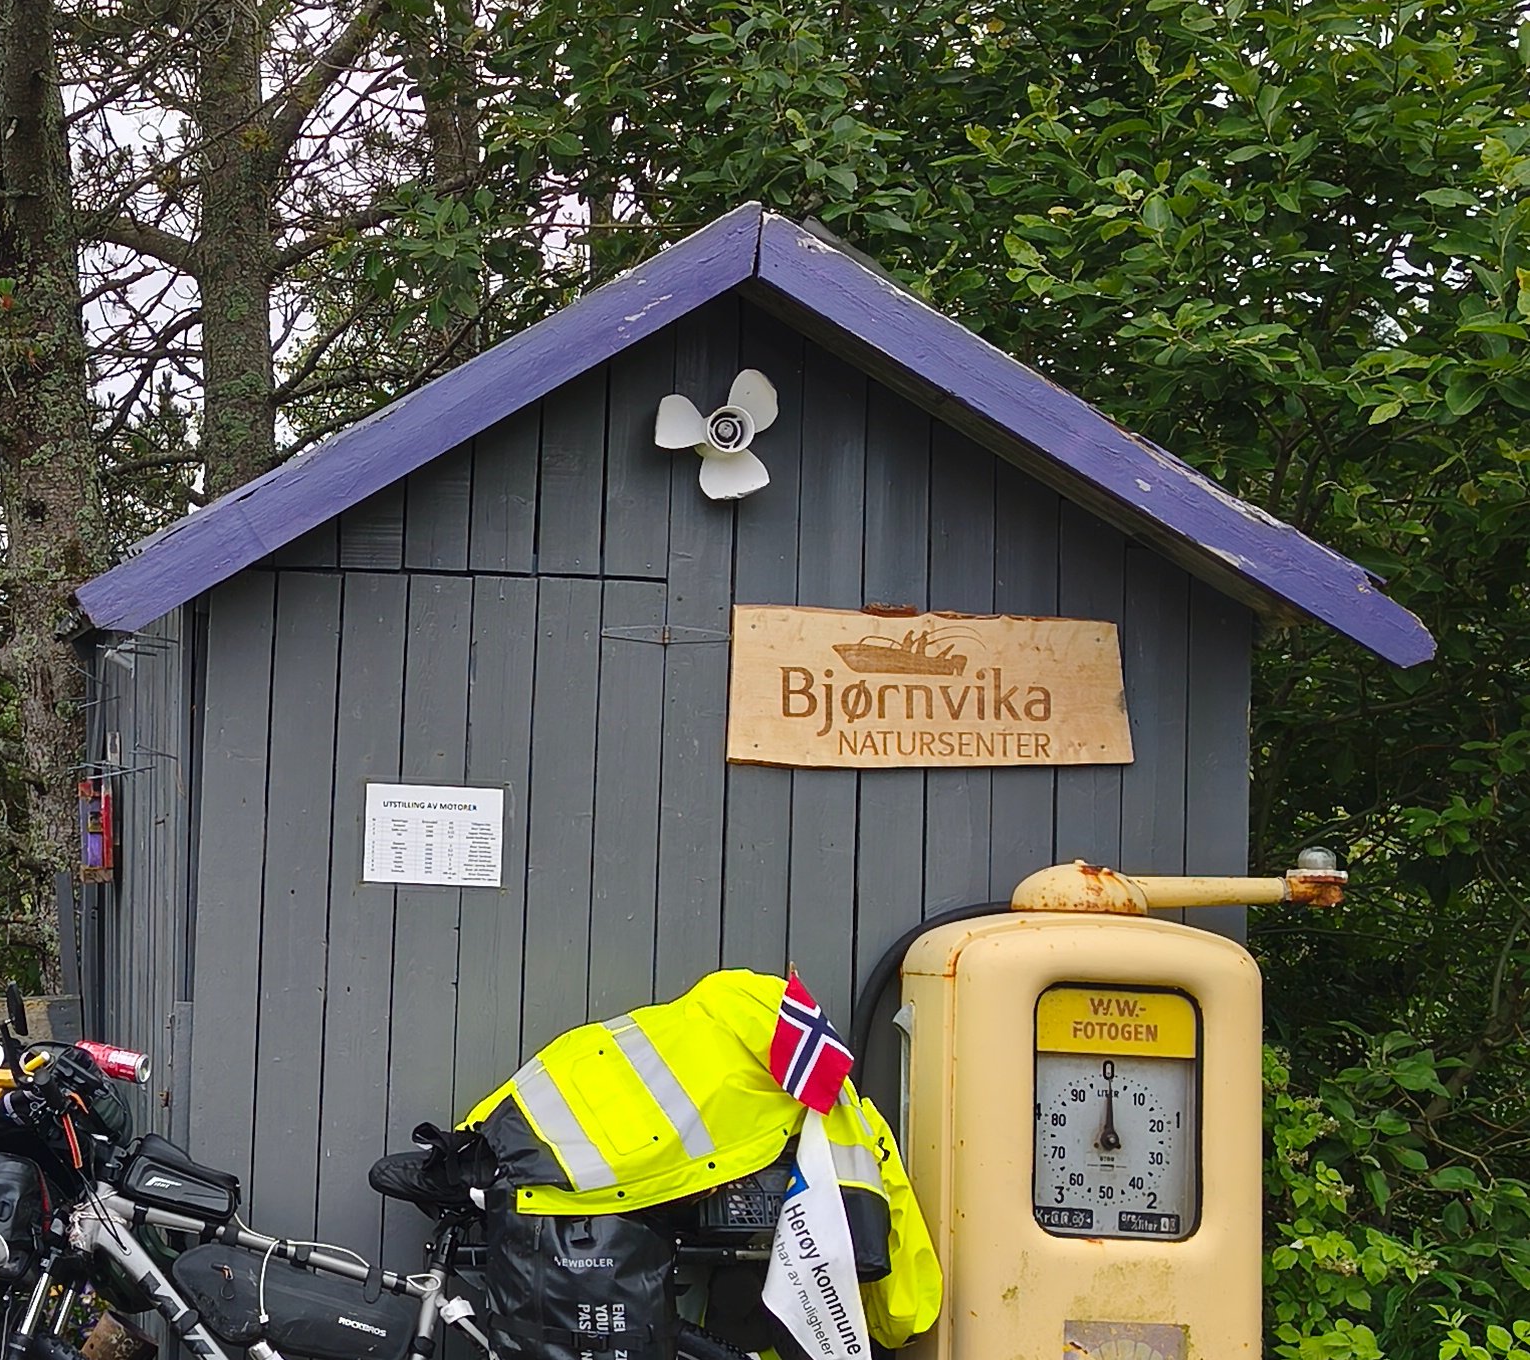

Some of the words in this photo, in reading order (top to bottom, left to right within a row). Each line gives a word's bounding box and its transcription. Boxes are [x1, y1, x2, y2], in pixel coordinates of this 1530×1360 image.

[778, 666, 1052, 737] Bjørnvika
[837, 730, 1051, 758] NATURSENTER
[382, 800, 425, 809] UTSTILLING
[427, 802, 438, 810] AV
[439, 803, 477, 811] MOTORER
[1072, 1021, 1158, 1042] FOTOGEN
[1102, 1060, 1115, 1081] 0
[1071, 1089, 1086, 1103] 90
[1132, 1093, 1146, 1106] 10
[1051, 1113, 1067, 1127] 80
[1148, 1119, 1164, 1133] 20
[1175, 1111, 1181, 1129] 1
[1051, 1146, 1066, 1159] 70
[1148, 1151, 1163, 1165] 30
[1069, 1173, 1084, 1186] 60
[1128, 1177, 1144, 1190] 40
[1054, 1186, 1065, 1204] 3
[1098, 1185, 1114, 1199] 50
[1146, 1191, 1158, 1210] 2
[784, 1203, 821, 1260] Herøy
[811, 1262, 862, 1356] kommune
[775, 1241, 793, 1267] hav
[788, 1270, 802, 1286] av
[798, 1289, 835, 1357] muligheter
[594, 1304, 610, 1337] YOU
